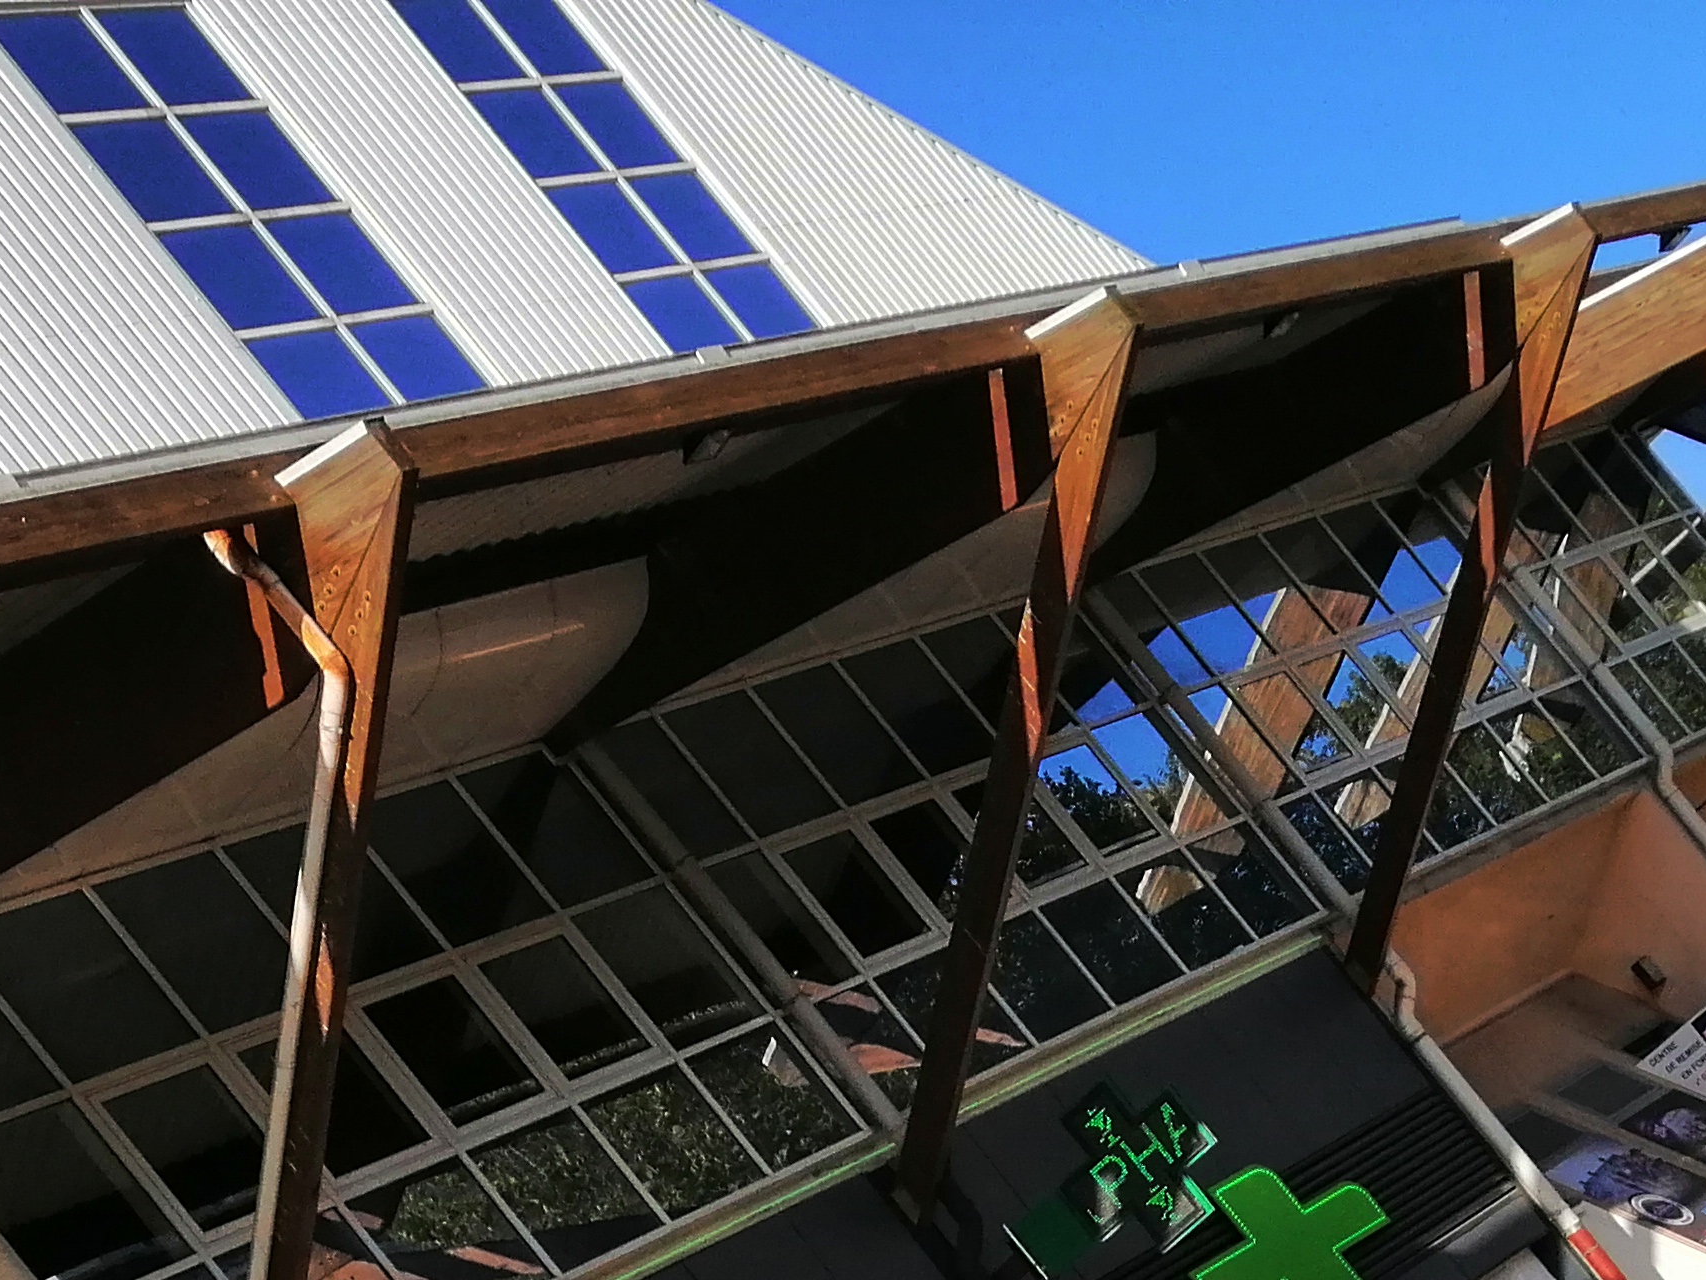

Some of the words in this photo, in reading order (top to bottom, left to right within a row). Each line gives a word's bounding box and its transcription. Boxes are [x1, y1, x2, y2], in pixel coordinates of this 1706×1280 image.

[1648, 1040, 1679, 1066] CENTRE
[1664, 1060, 1678, 1073] DE
[1674, 1038, 1703, 1064] REMISE
[1679, 1065, 1693, 1079] EN
